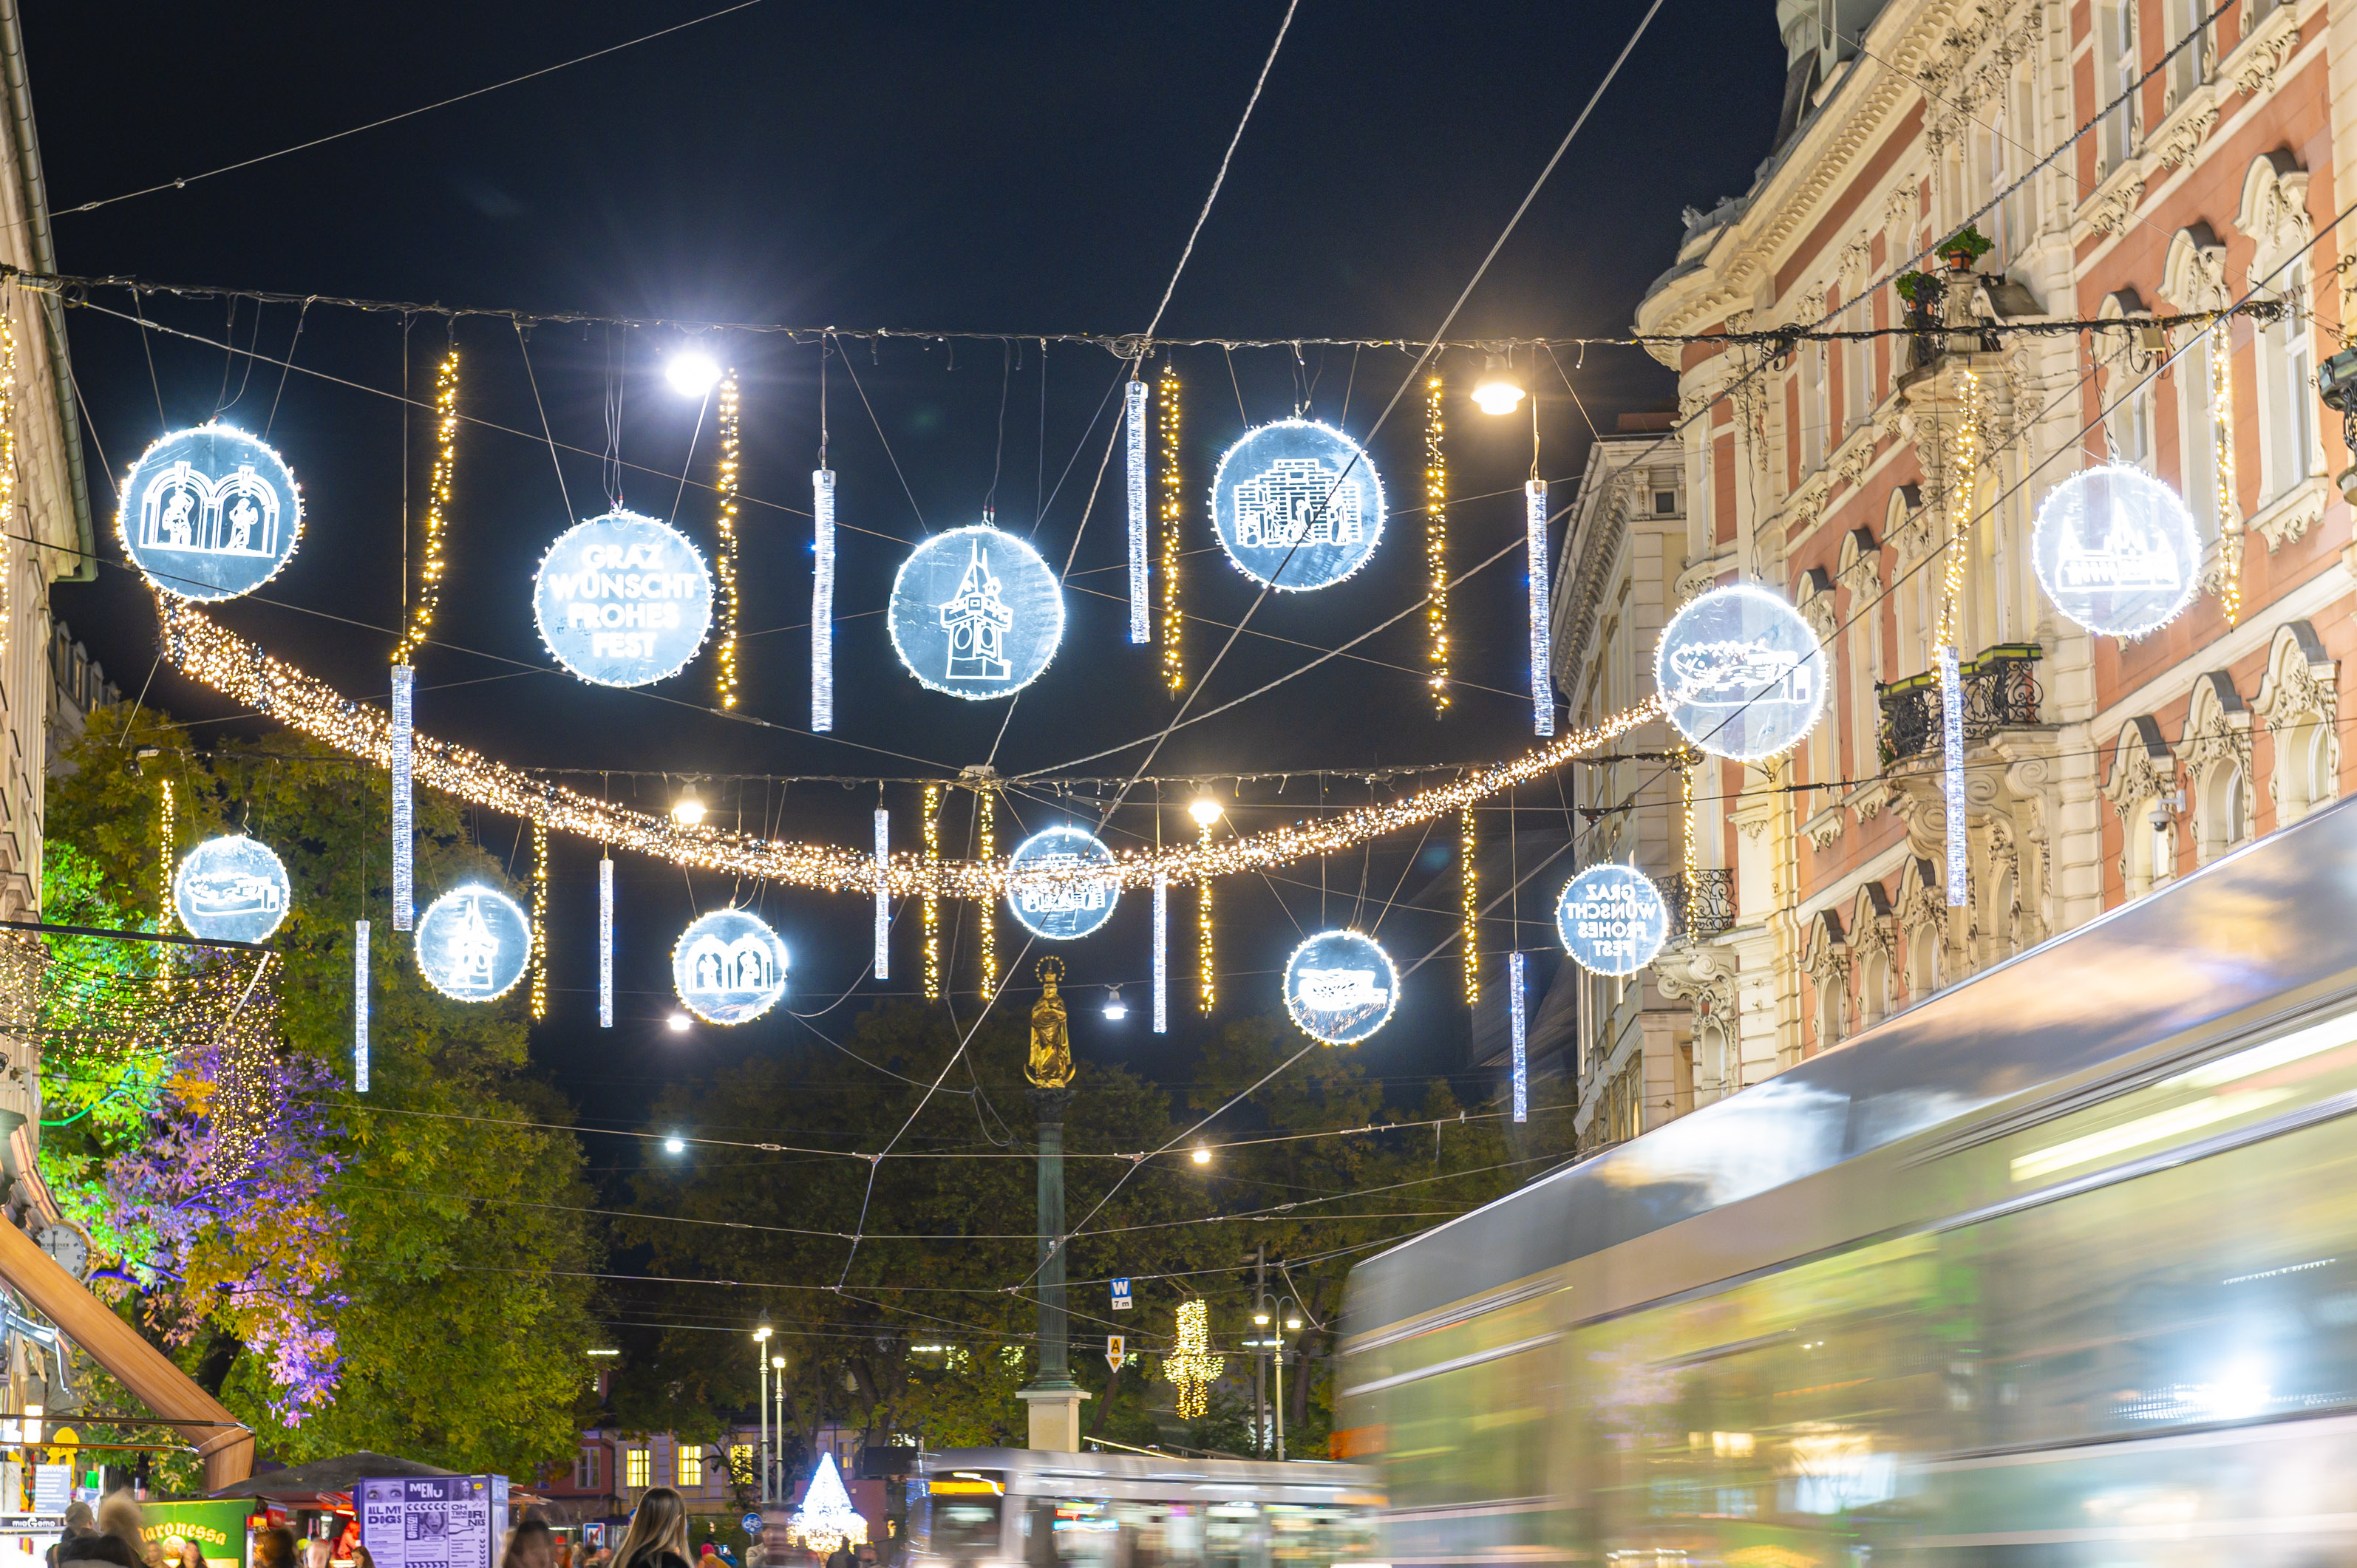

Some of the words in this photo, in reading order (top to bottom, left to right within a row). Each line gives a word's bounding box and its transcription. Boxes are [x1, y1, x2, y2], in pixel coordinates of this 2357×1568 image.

[582, 544, 664, 570] GRAZ
[548, 570, 698, 601] WÜNSCHT
[568, 602, 680, 629] FROHES
[592, 632, 658, 658] FEST
[1112, 1281, 1129, 1295] W
[1111, 1339, 1120, 1354] A
[36, 1465, 69, 1473] SERVICE
[409, 1483, 443, 1498] MENU
[368, 1506, 384, 1515] ALL
[385, 1505, 402, 1514] MY
[368, 1515, 402, 1524] DOGS
